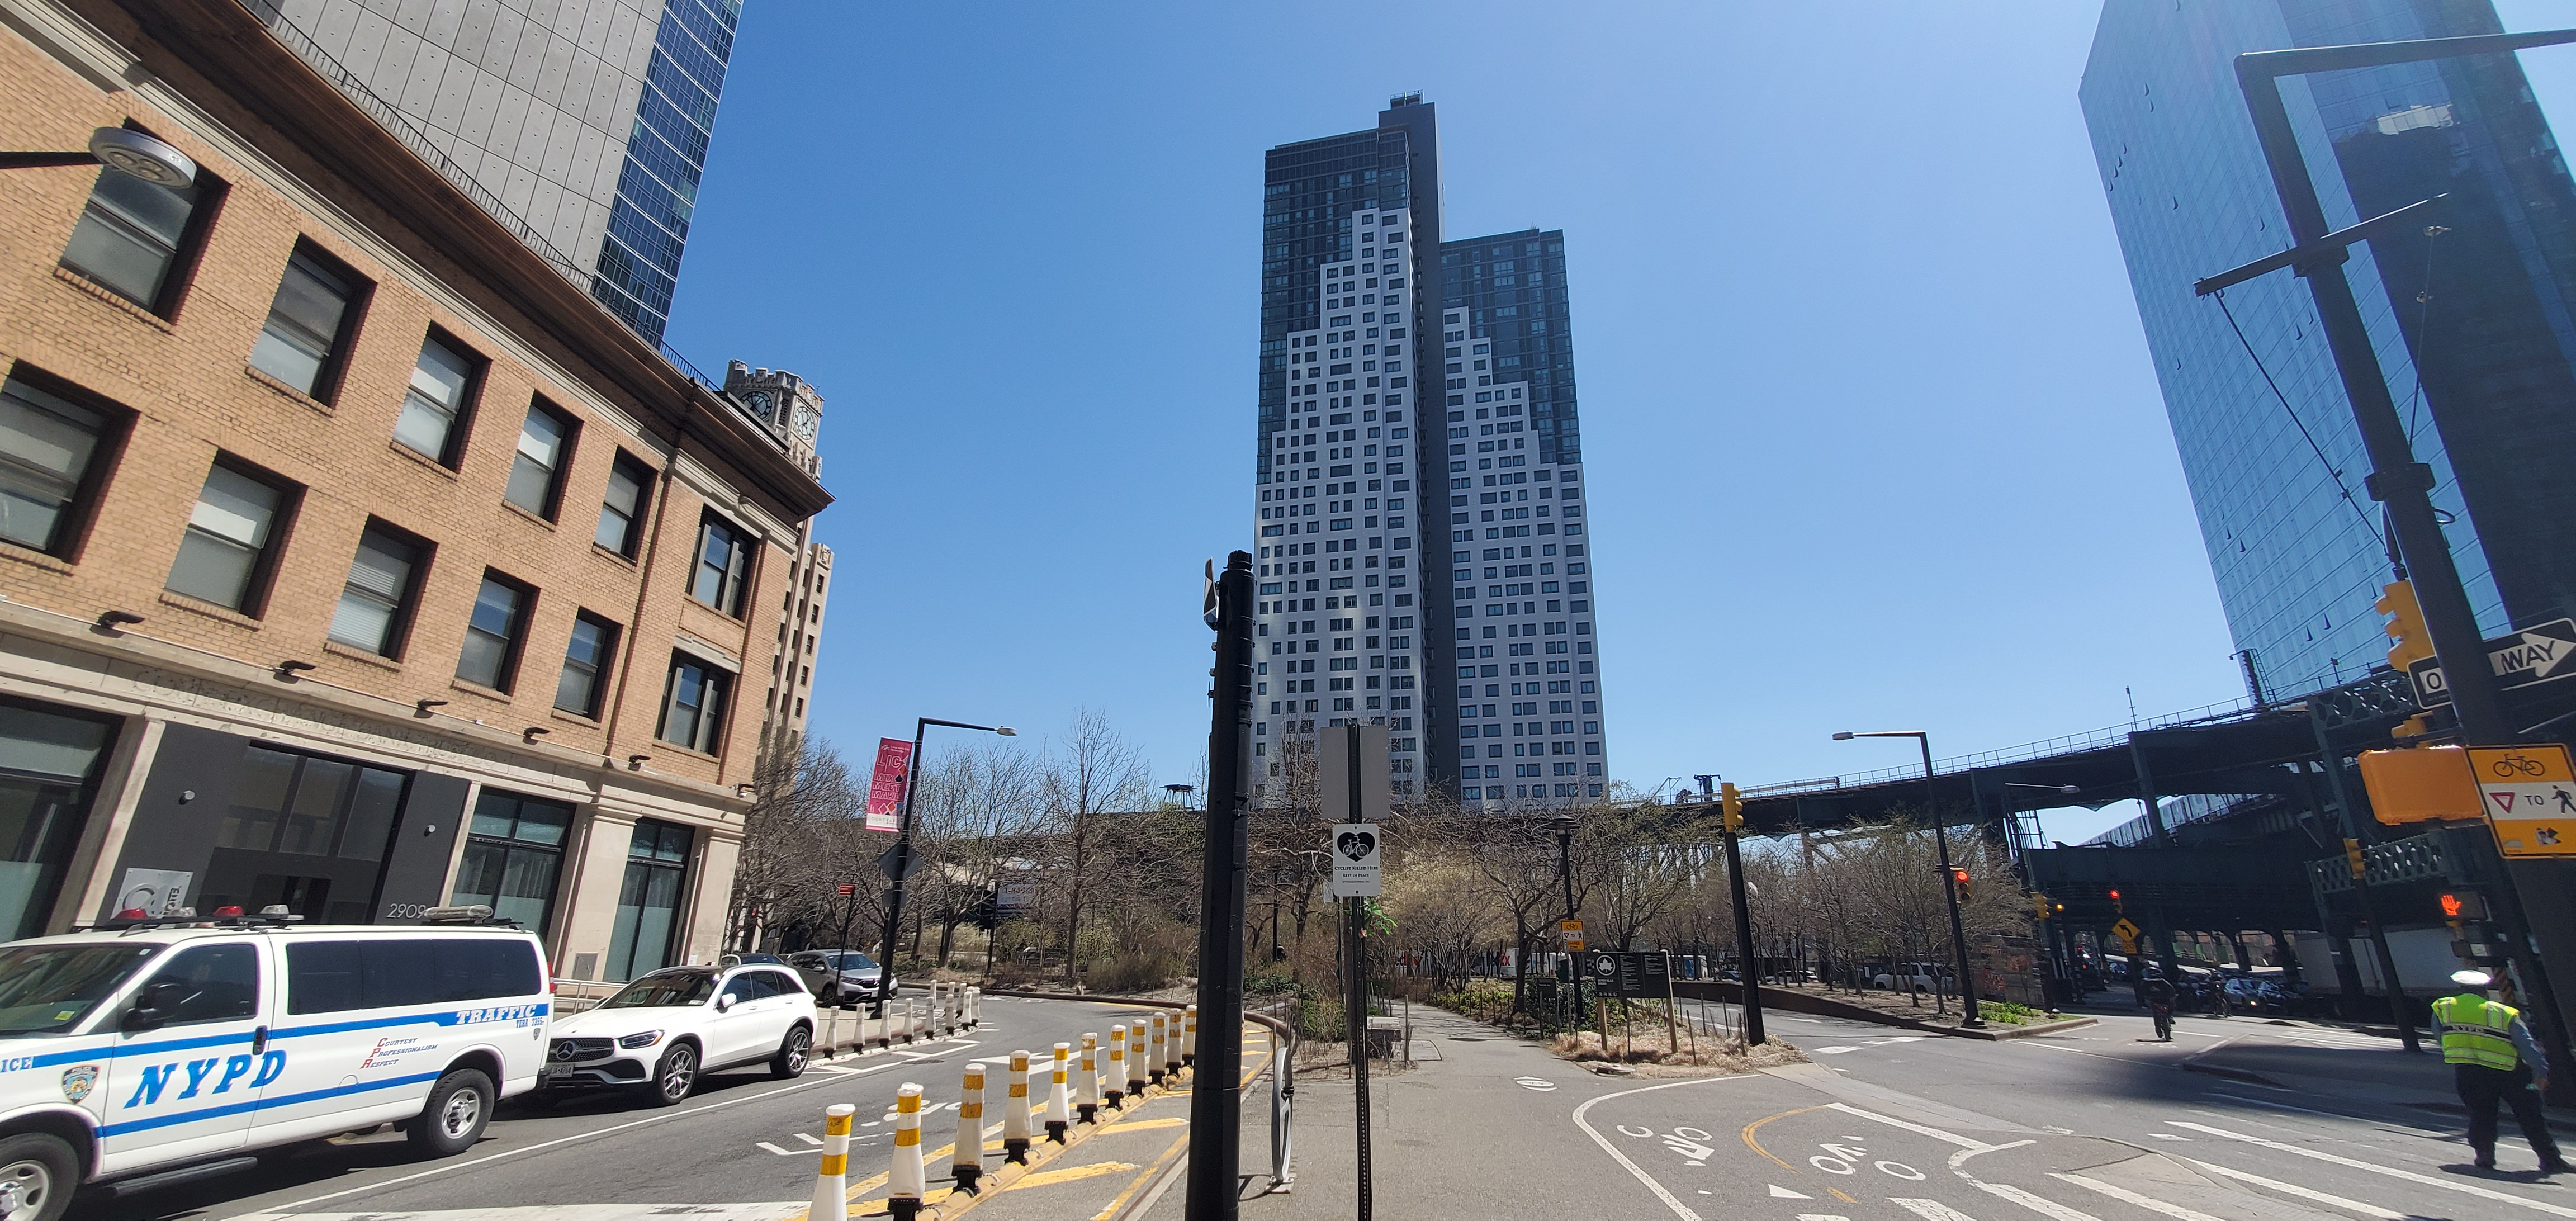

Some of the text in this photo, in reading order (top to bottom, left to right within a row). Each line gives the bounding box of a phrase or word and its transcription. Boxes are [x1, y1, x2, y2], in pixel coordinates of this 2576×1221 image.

[2501, 640, 2555, 674] WAY
[874, 770, 894, 782] MIX
[872, 781, 901, 792] MEET
[872, 791, 902, 801] MAKE
[2524, 795, 2544, 806] TO
[386, 903, 427, 919] 2909
[457, 1004, 537, 1024] TRAFFIC
[377, 1037, 418, 1047] COURTESY
[369, 1044, 438, 1058] PROFESSIONALISM
[0, 1056, 31, 1073] ICE
[359, 1059, 400, 1069] RESPECT
[123, 1049, 287, 1109] NYPD
